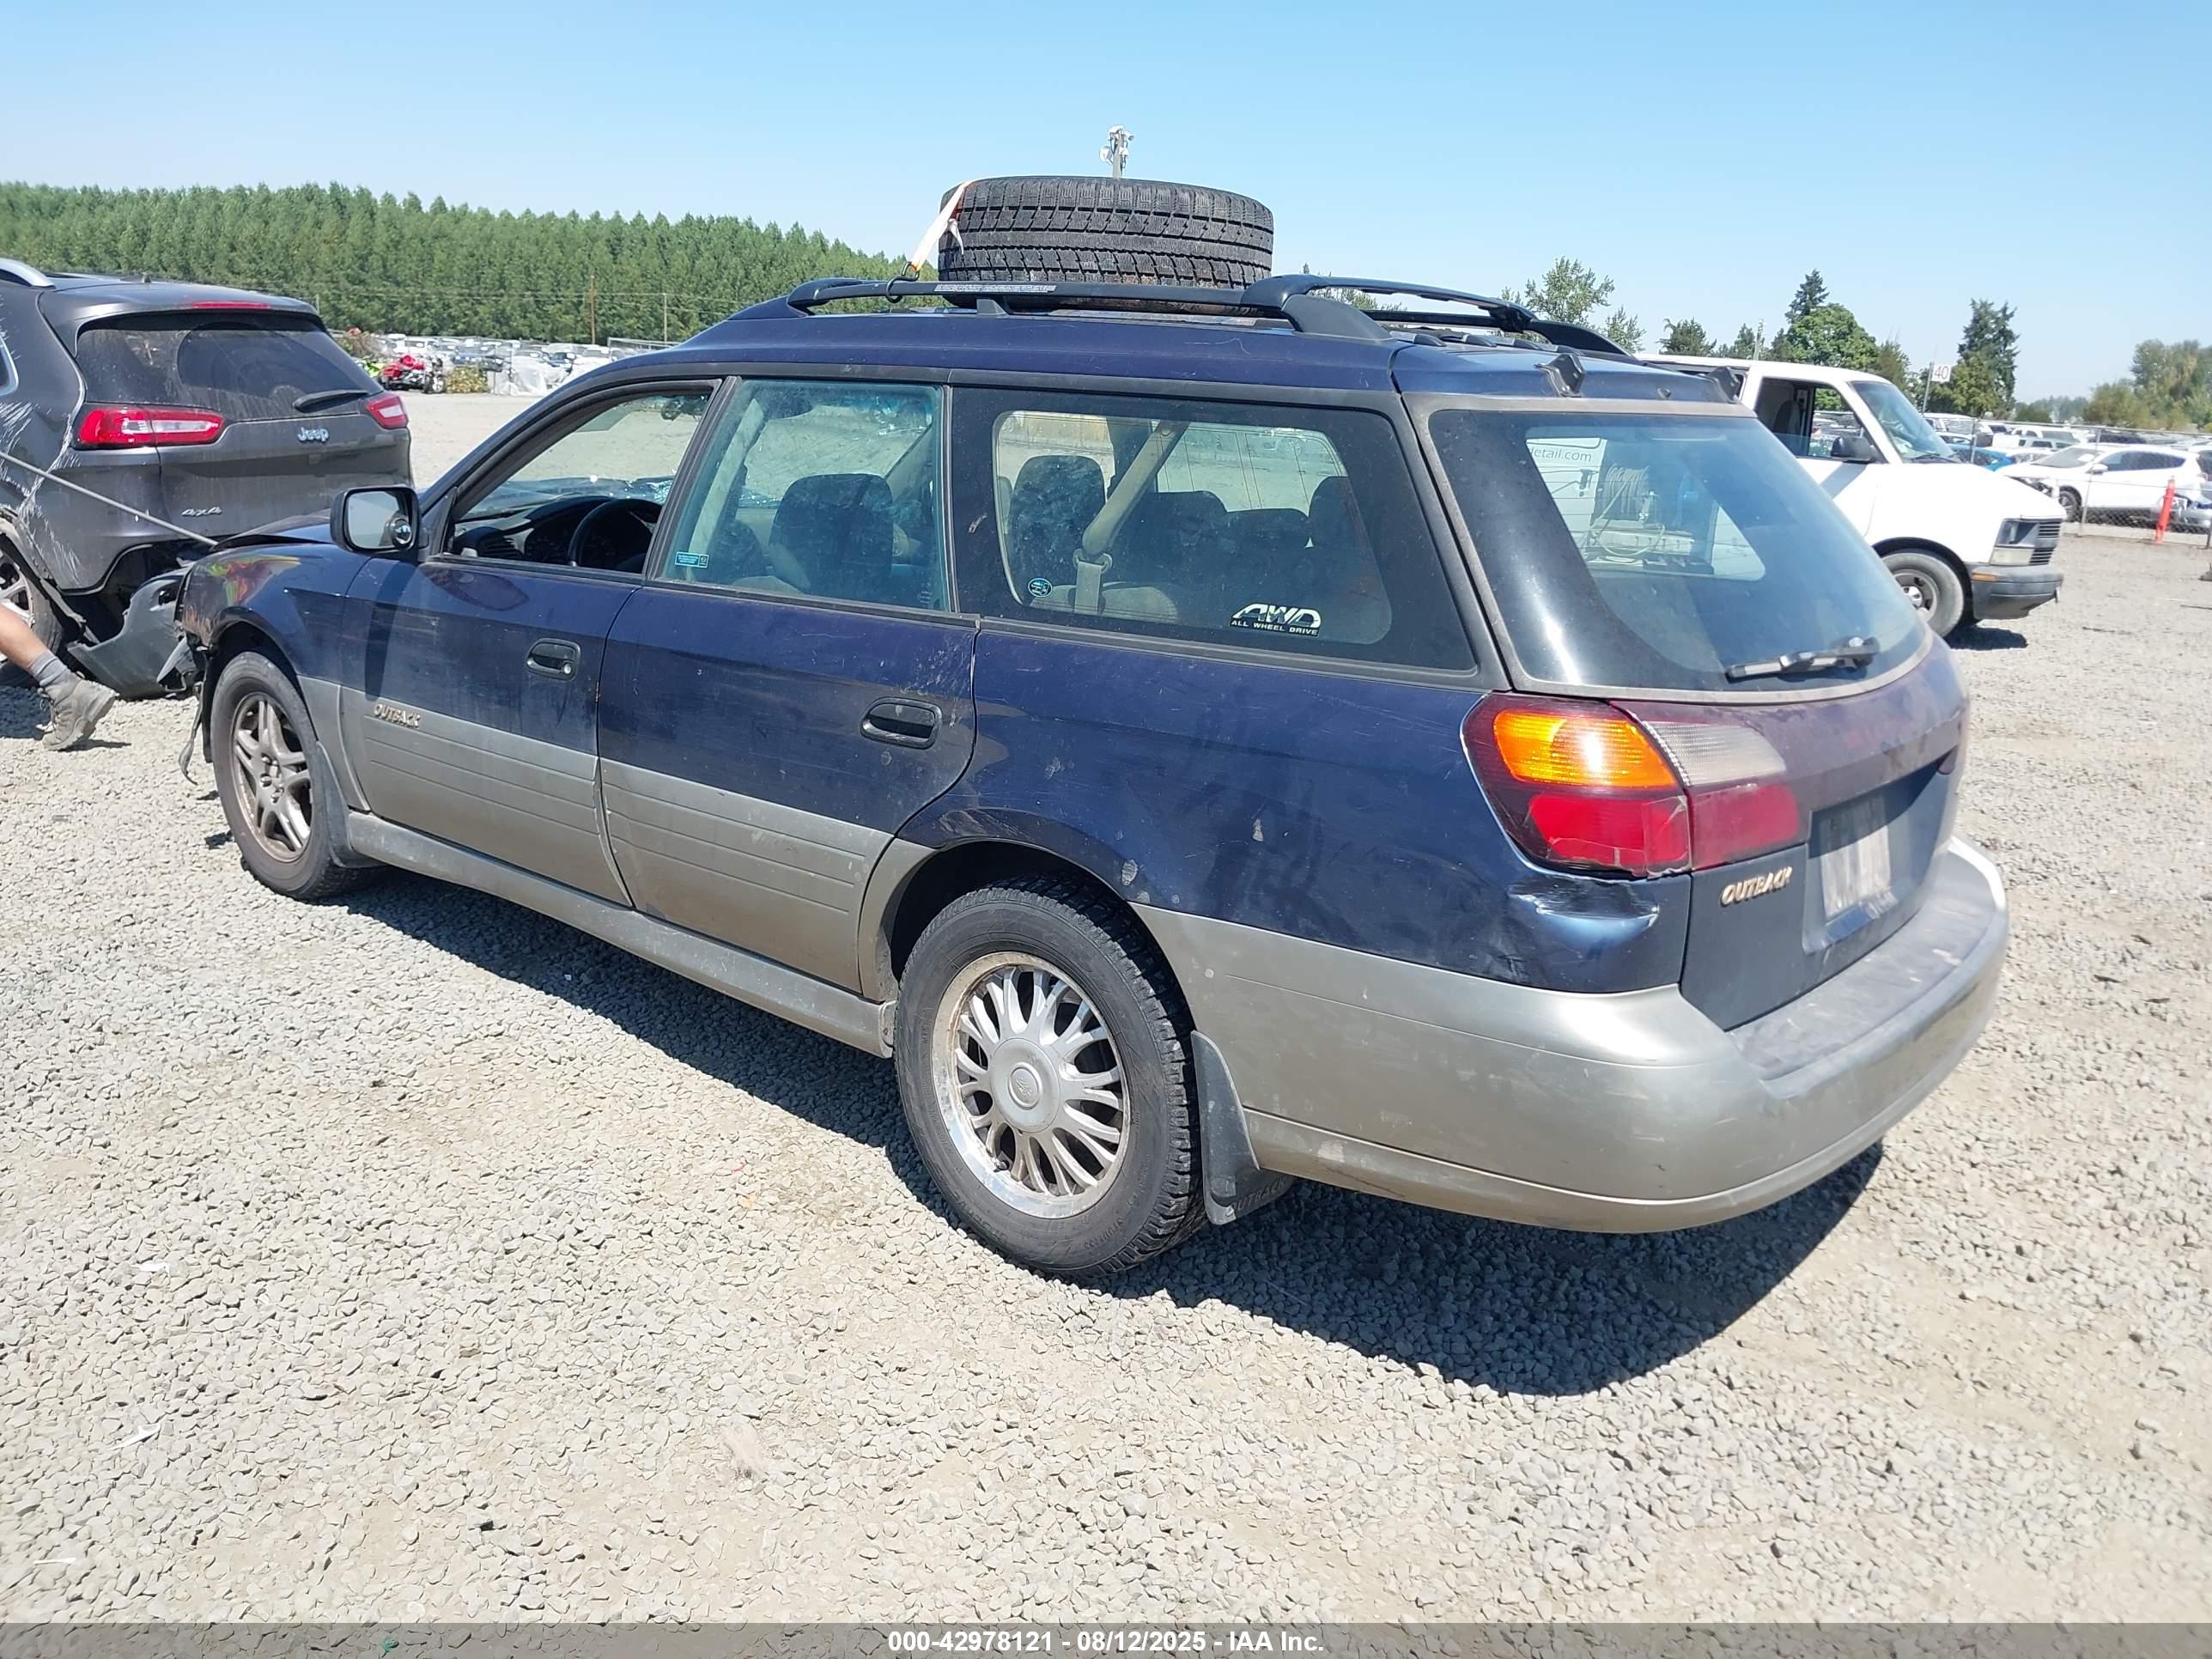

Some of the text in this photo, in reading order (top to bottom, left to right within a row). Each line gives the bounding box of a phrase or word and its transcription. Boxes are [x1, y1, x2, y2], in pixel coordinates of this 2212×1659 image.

[1935, 365, 1949, 380] 40
[297, 427, 330, 442] Jeep
[1231, 603, 1322, 629] AWD
[1253, 623, 1285, 632] WHEEL
[1289, 627, 1319, 636] DRIVE
[374, 703, 422, 729] OUTBACK
[1720, 866, 1793, 907] OUTBACK
